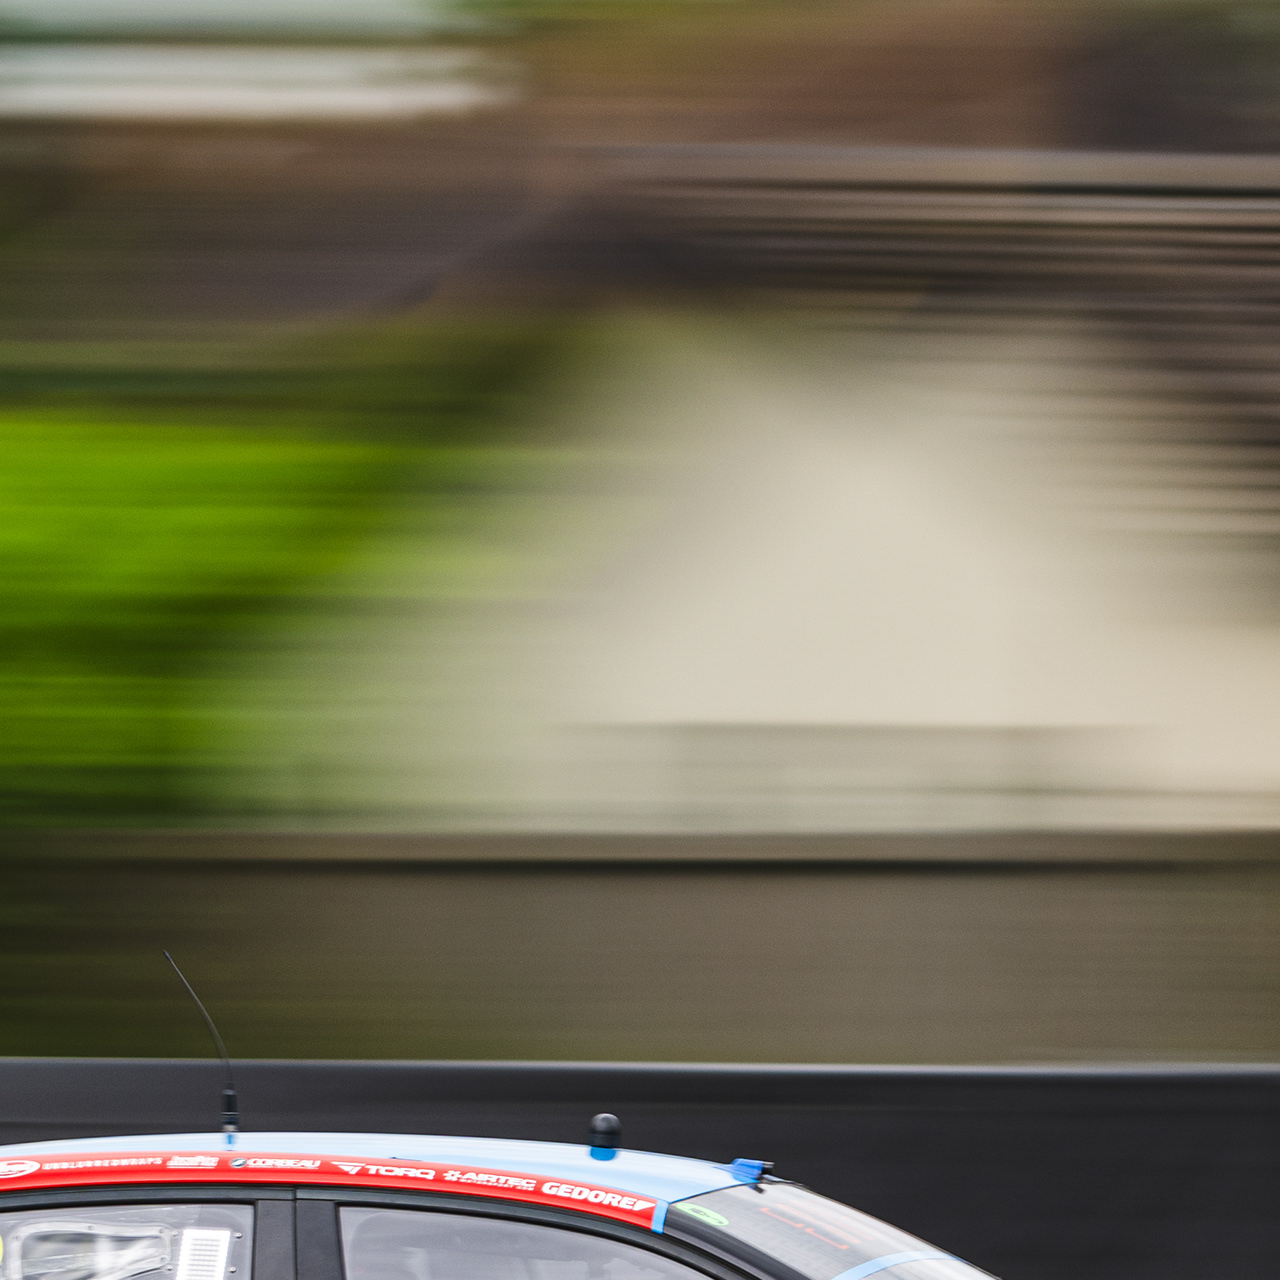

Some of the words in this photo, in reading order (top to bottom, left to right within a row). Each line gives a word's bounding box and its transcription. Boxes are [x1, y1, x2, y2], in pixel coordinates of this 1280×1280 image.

[365, 1165, 436, 1180] TORQ
[461, 1172, 538, 1187] AIRTEC
[541, 1181, 637, 1211] GEDORE
